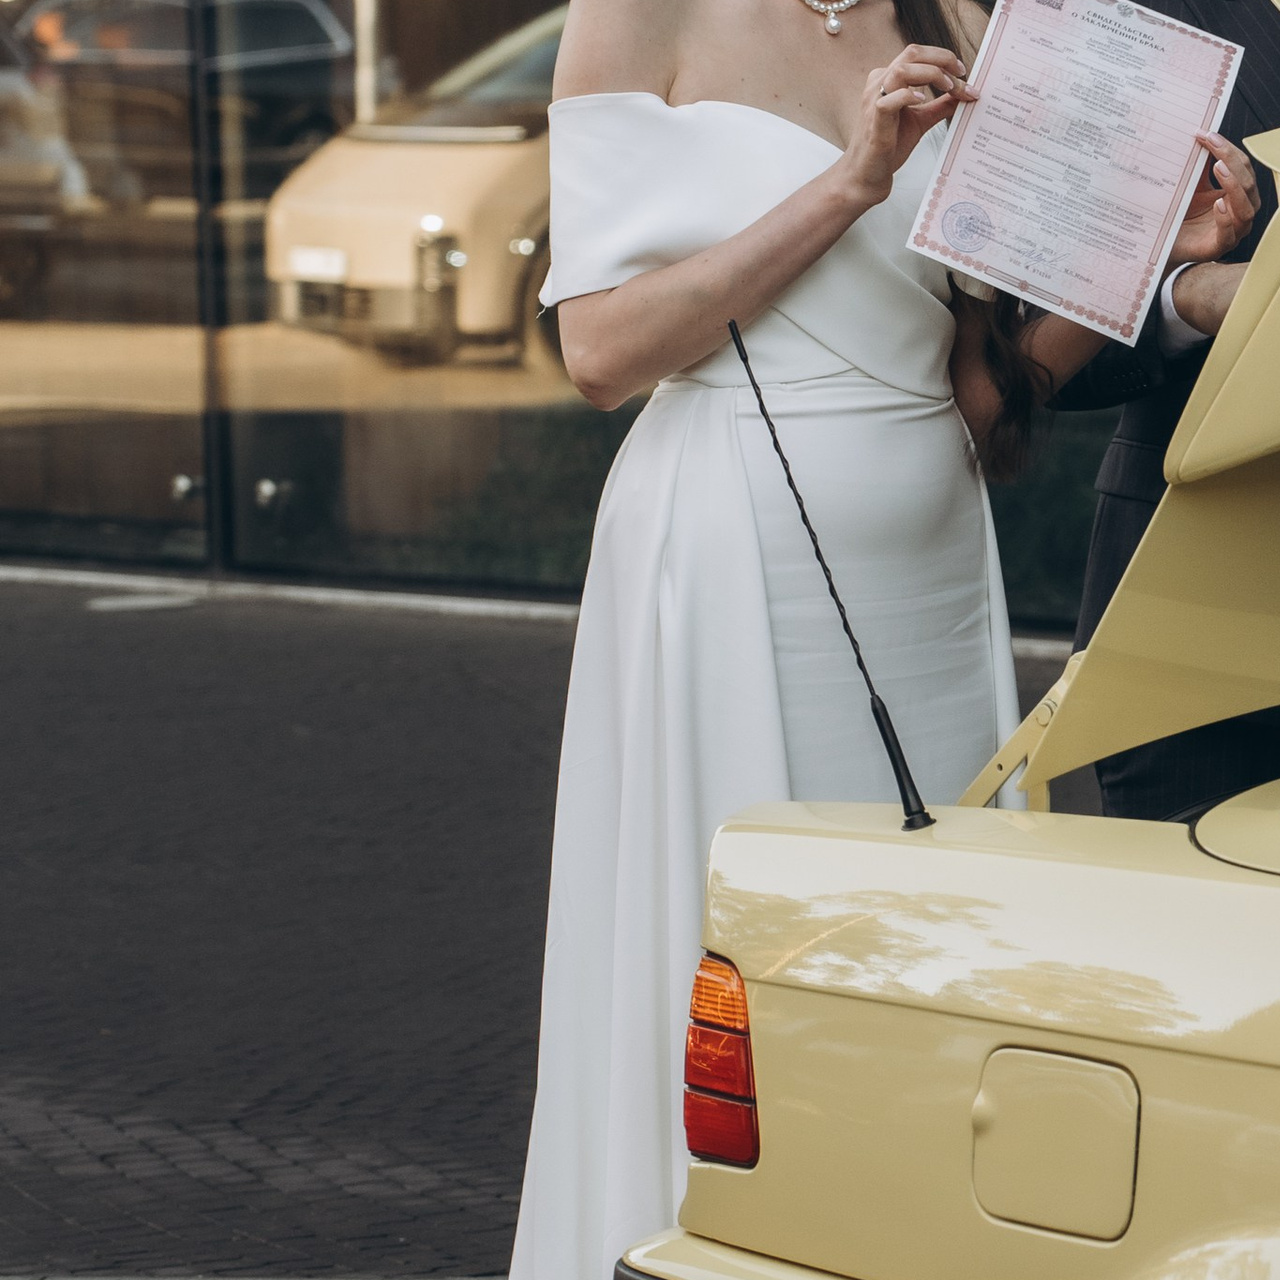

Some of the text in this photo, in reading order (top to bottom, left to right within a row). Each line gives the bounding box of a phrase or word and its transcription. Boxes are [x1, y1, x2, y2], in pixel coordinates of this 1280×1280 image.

[1079, 14, 1137, 42] ЗАКЛЮЧЕНИИ
[1139, 38, 1165, 53] БРАКА
[1086, 10, 1154, 42] СВИДЕТЕЛЬСТВО
